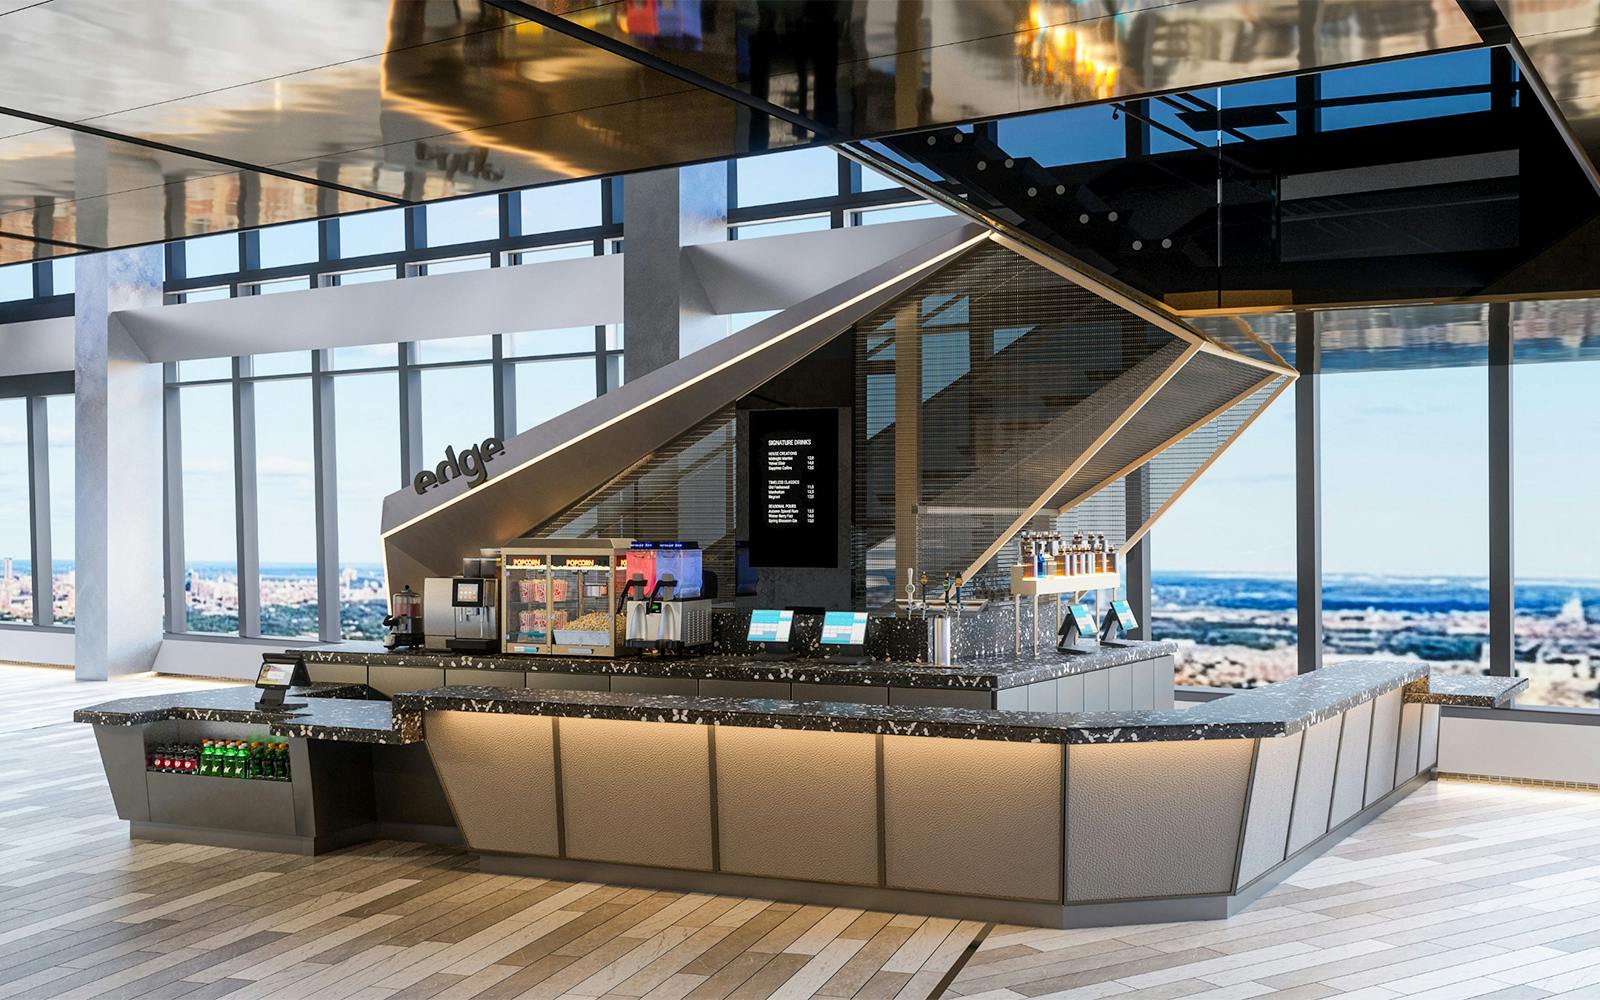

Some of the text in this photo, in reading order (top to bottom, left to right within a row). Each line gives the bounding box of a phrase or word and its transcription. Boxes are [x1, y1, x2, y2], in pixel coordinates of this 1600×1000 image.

[414, 437, 506, 495] edge
[513, 558, 541, 566] POPCORN
[566, 558, 595, 567] POPCORN
